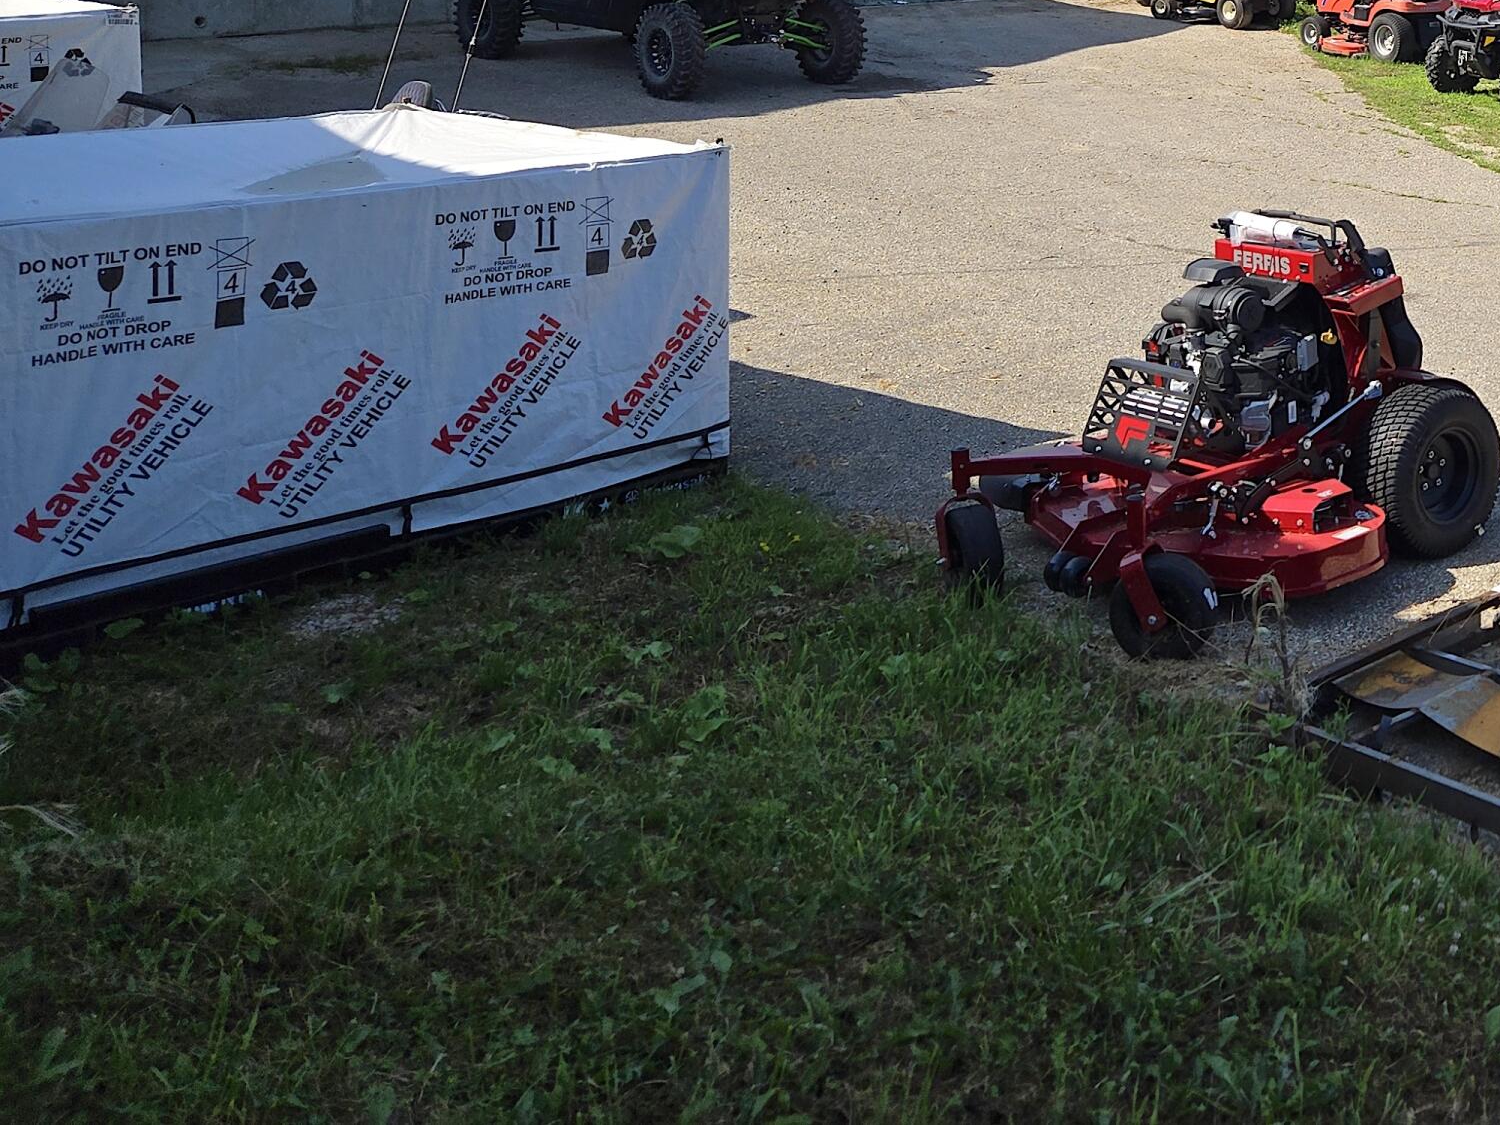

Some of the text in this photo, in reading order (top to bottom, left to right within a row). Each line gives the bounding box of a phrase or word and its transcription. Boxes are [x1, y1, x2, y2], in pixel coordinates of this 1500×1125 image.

[34, 52, 44, 64] 4
[435, 200, 576, 225] DO NOT TILT ON END
[591, 227, 604, 246] 4
[19, 241, 202, 276] DO NOT TILT ON END
[223, 272, 239, 294] 4
[285, 279, 297, 295] 4
[444, 278, 571, 305] HANDLE WITH CARE
[464, 267, 552, 287] DO NOT DROP
[1233, 249, 1290, 275] FERRIS
[31, 332, 196, 368] HANDLE WITH CARE
[58, 320, 172, 347] DO NOT DROP
[106, 317, 125, 327] WITH
[126, 315, 145, 324] CARE
[431, 313, 562, 456] Kawasaki
[602, 294, 713, 427] Kawasaki
[624, 409, 645, 430] Let
[644, 391, 660, 409] the
[658, 362, 681, 391] good
[679, 333, 705, 363] times
[632, 316, 729, 440] UTILITY VEHICLE
[236, 349, 385, 505] Kawasaki
[458, 434, 483, 458] Let
[479, 414, 501, 436] the
[498, 385, 525, 417] good
[522, 354, 550, 386] times
[468, 335, 582, 469] UTILITY VEHICLE
[14, 374, 181, 544] Kawasaki
[51, 392, 193, 546] Let the good times roll.
[269, 367, 395, 508] Let the good times roll.
[278, 374, 412, 519] UTILITY VEHICLE
[60, 399, 214, 558] UTILITY VEHICLE
